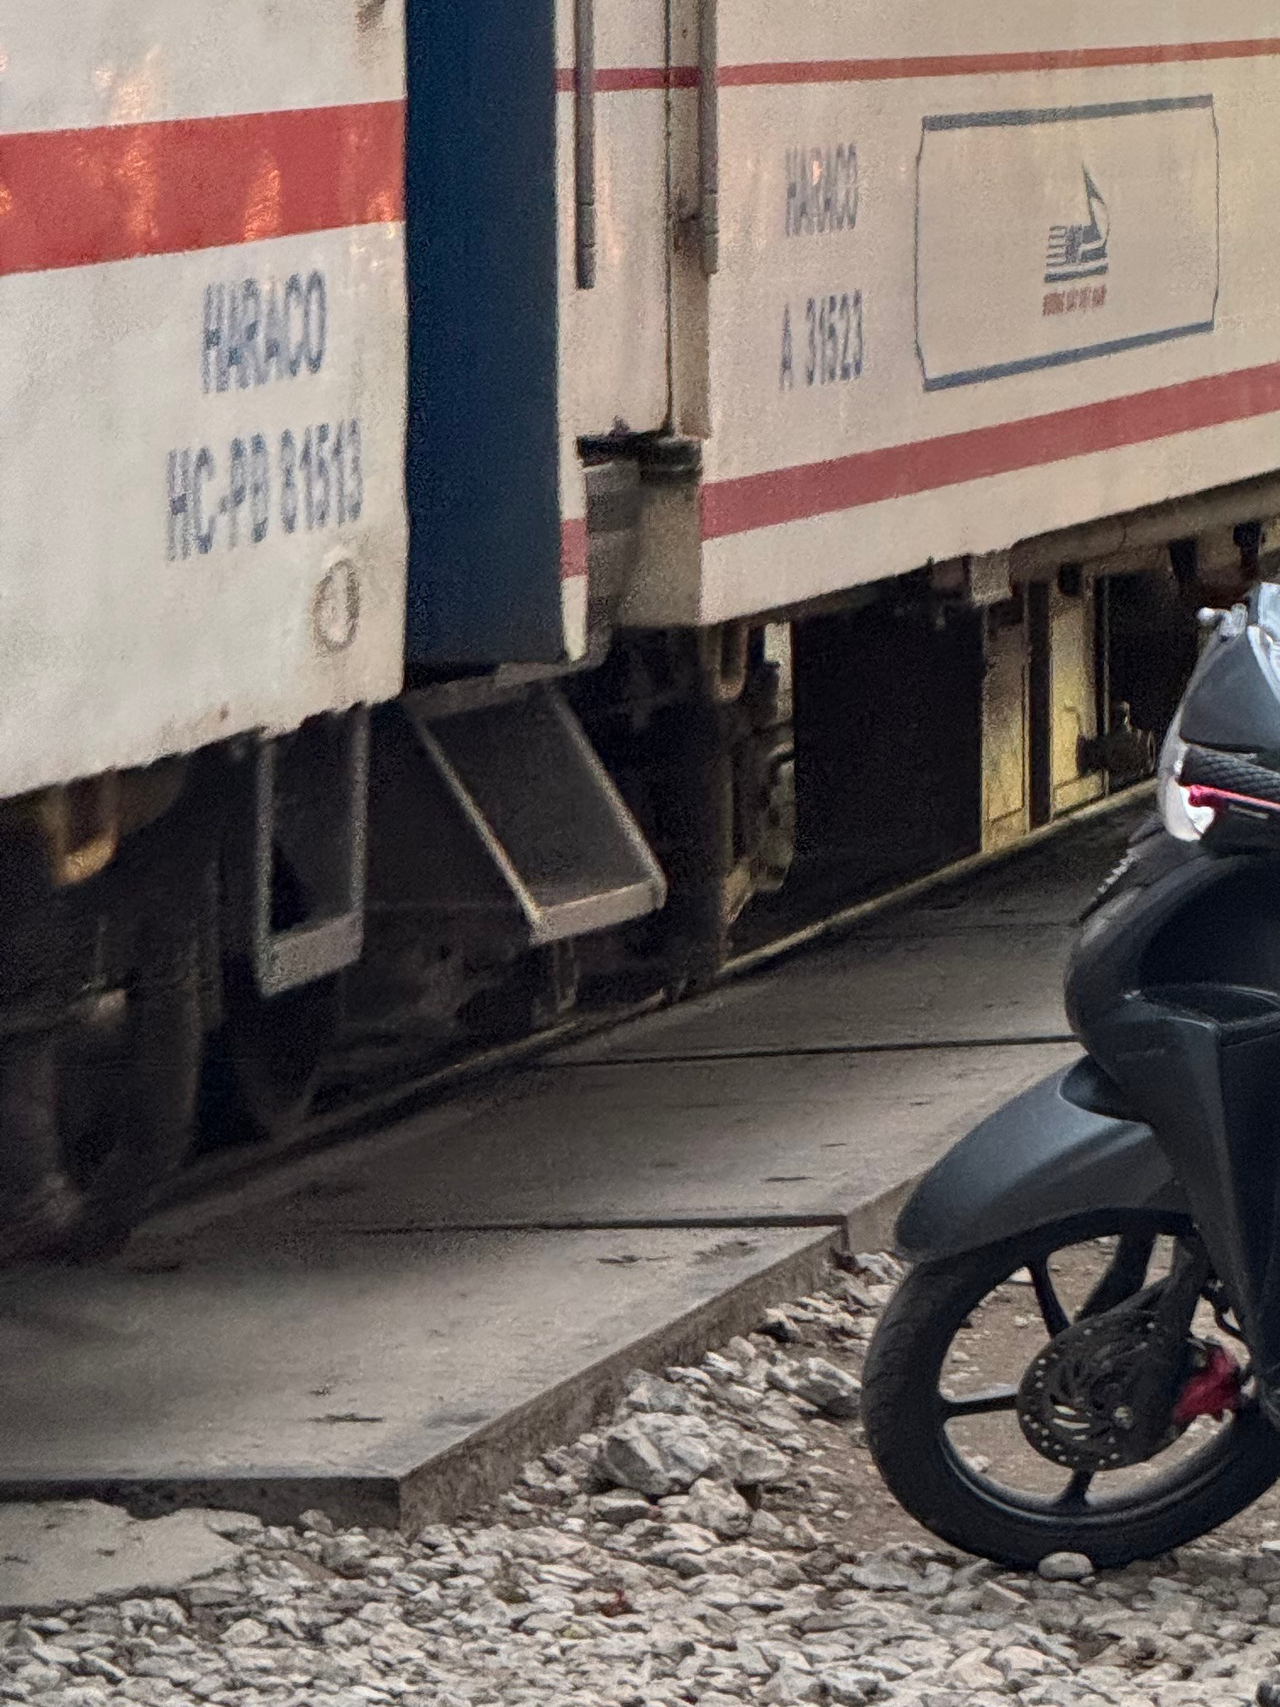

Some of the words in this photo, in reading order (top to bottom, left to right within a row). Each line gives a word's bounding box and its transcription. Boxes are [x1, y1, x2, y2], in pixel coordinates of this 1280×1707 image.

[785, 143, 858, 237] HARACO
[202, 269, 327, 393] HARACO
[779, 302, 794, 391] A
[806, 288, 863, 386] 31523
[279, 416, 364, 534] 81513
